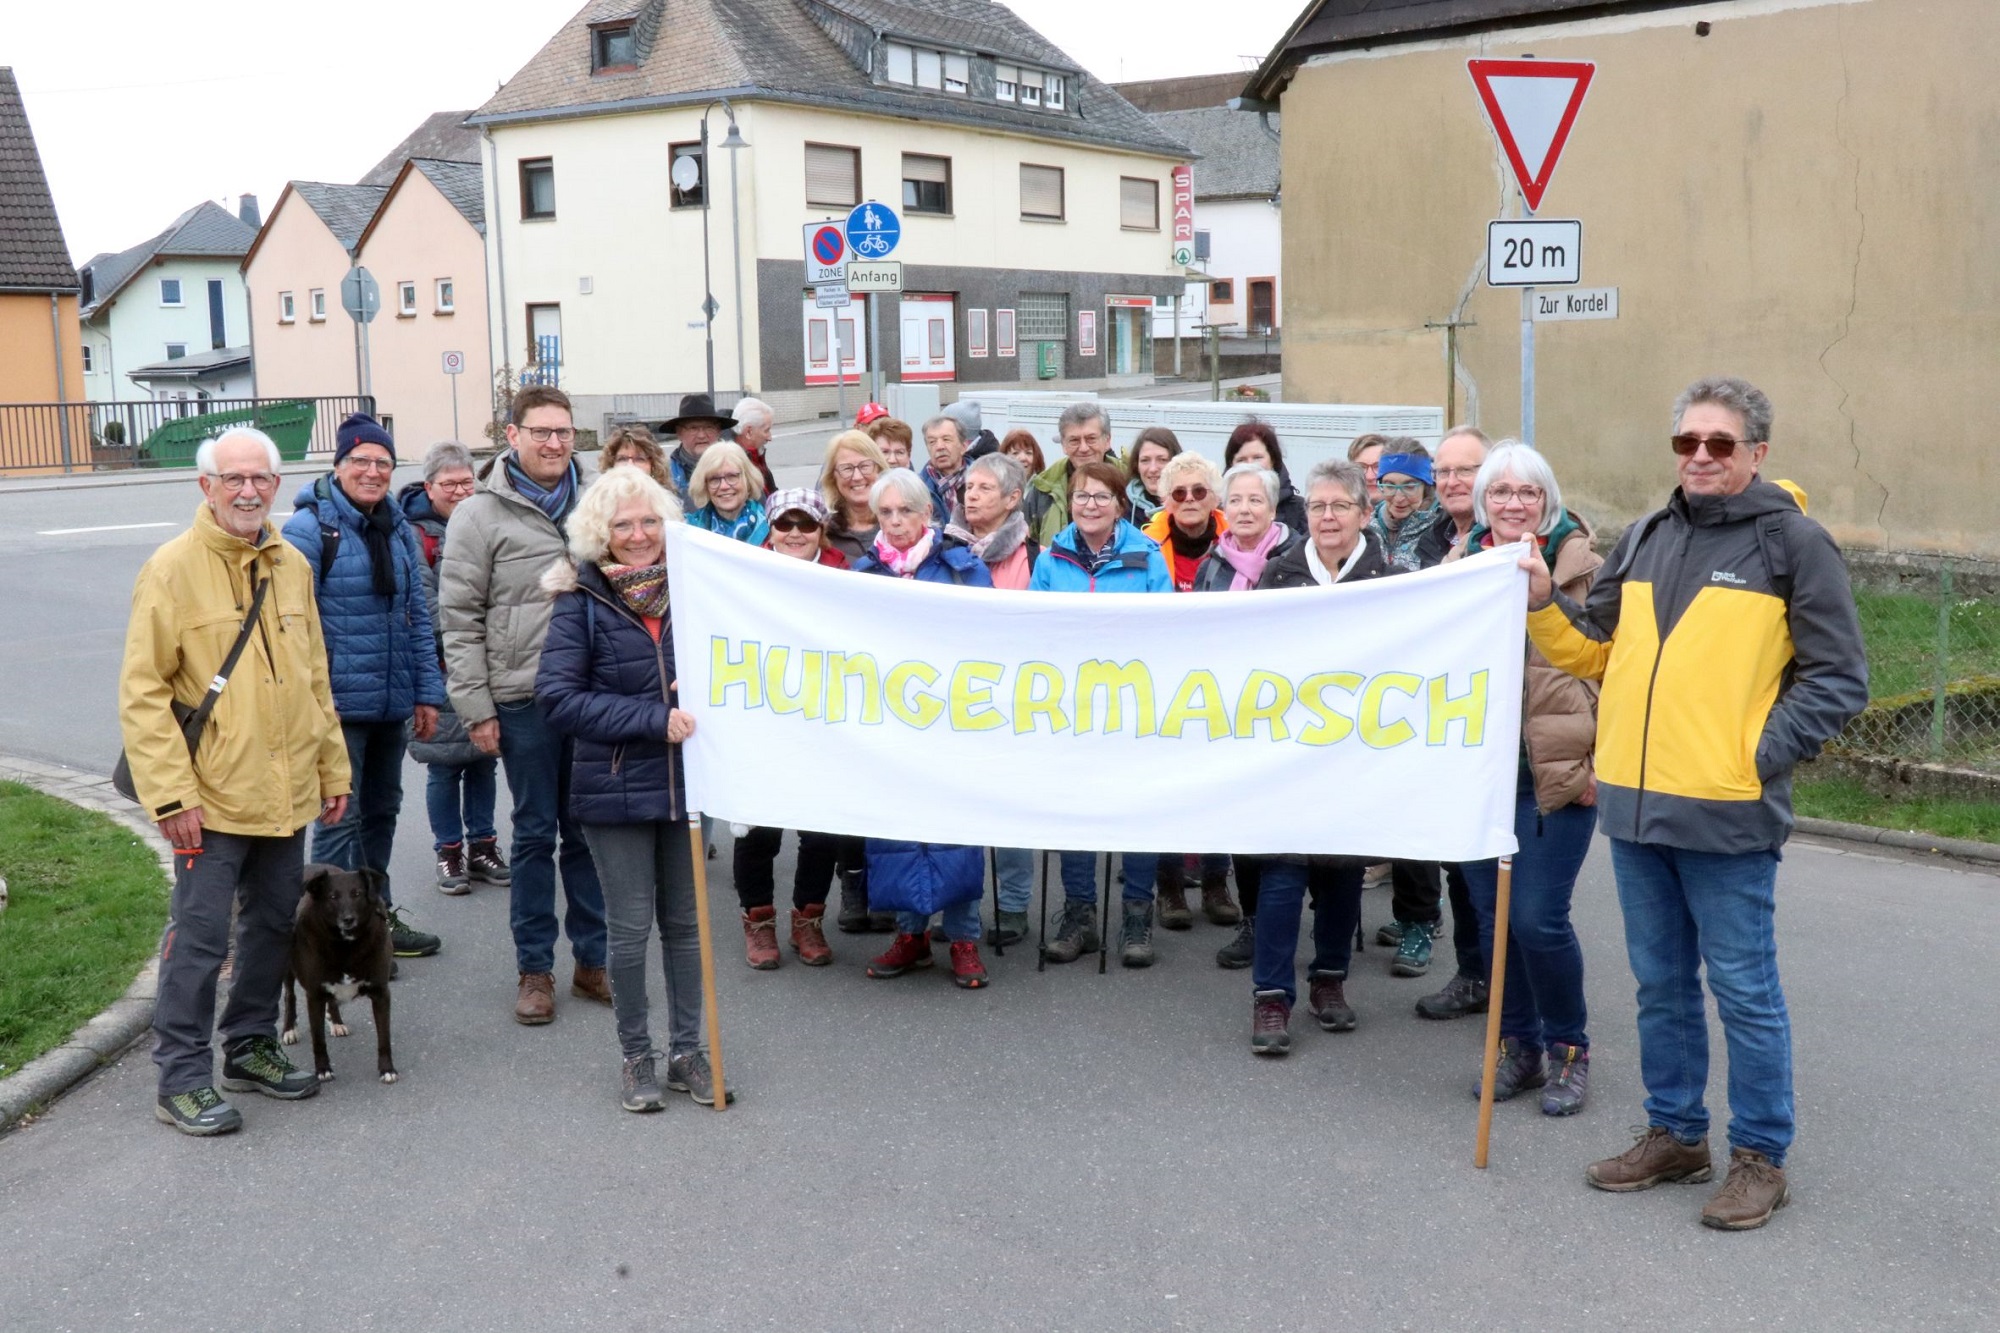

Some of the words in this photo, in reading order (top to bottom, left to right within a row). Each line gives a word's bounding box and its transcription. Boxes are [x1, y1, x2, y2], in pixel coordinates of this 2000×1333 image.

[1175, 174, 1191, 237] SPAR
[1503, 238, 1534, 268] 20
[1542, 245, 1565, 268] m
[818, 266, 843, 279] ZONE
[851, 270, 897, 285] Anfang
[1540, 296, 1559, 314] Zur
[1567, 292, 1608, 313] Kordel
